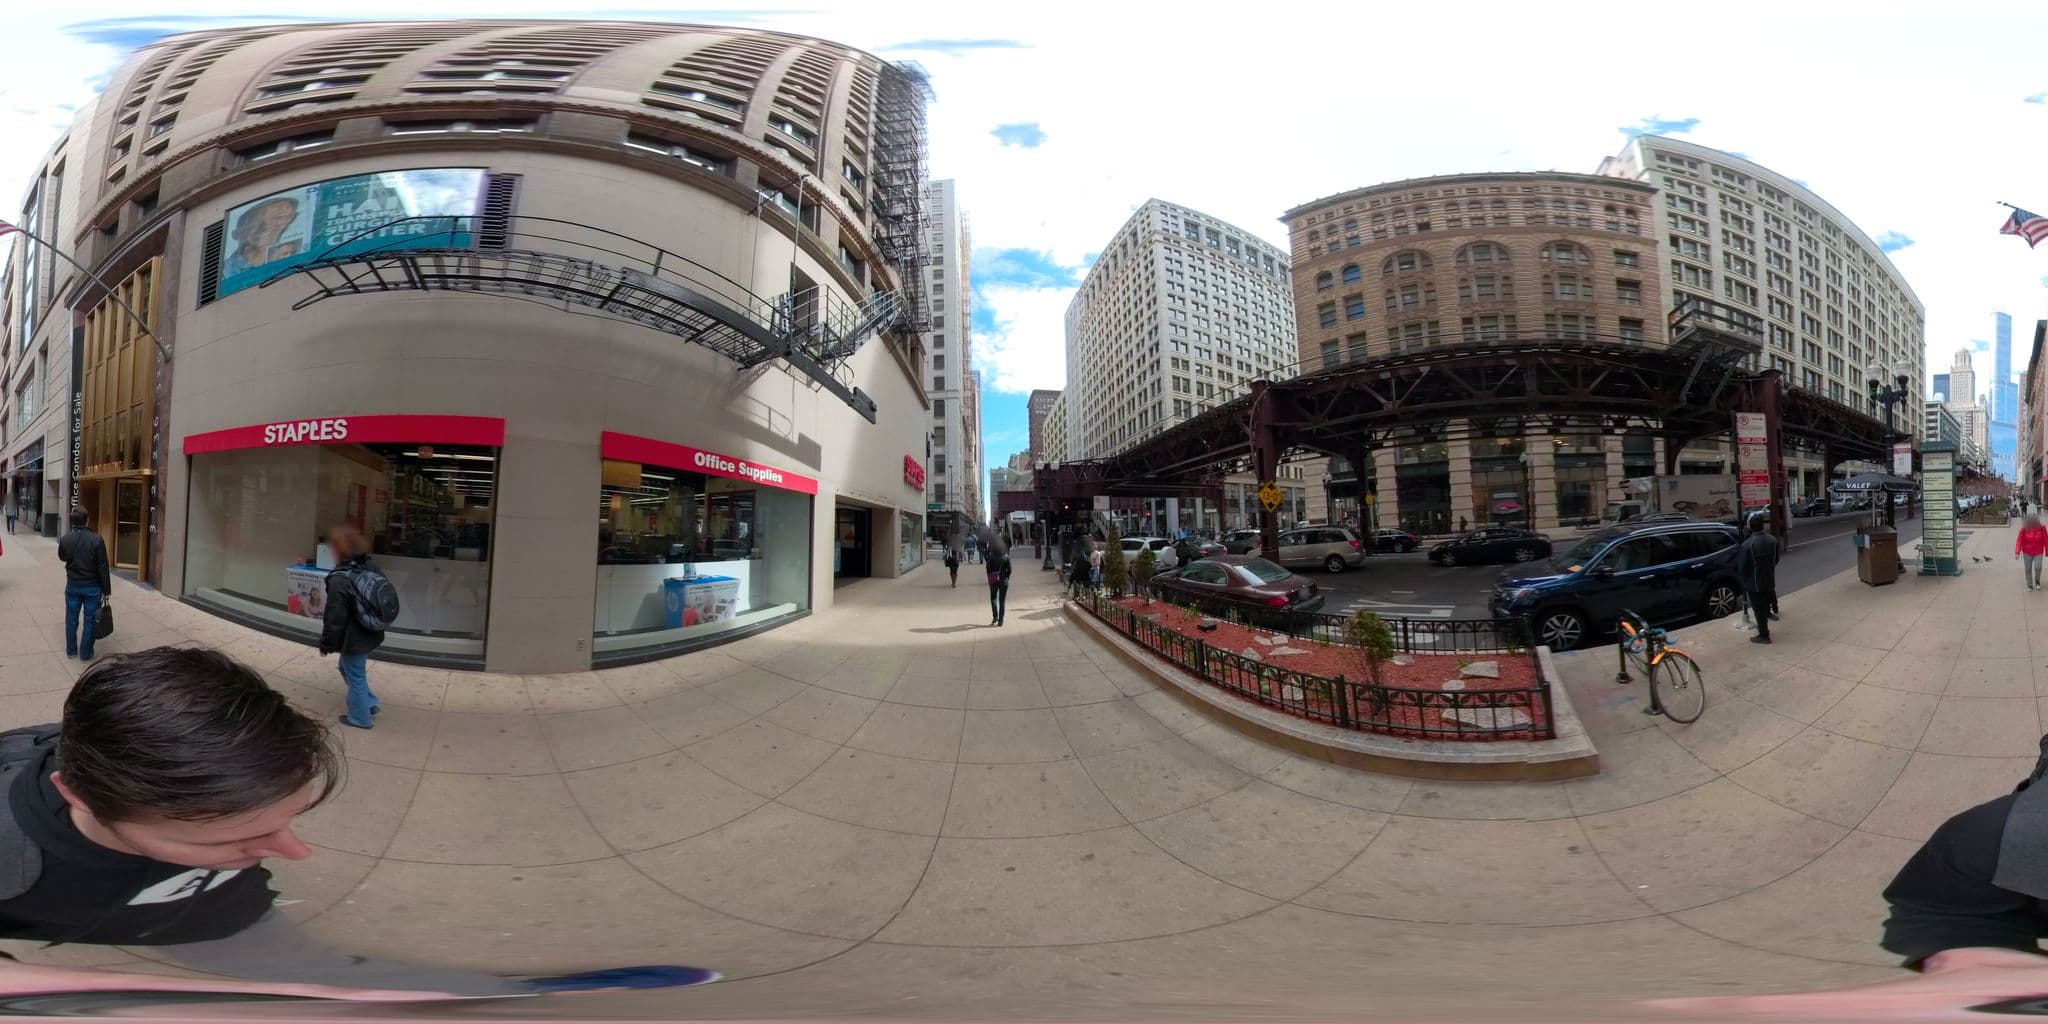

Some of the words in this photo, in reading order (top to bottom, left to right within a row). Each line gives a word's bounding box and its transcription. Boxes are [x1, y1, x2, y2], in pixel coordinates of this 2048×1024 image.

[327, 196, 400, 219] HAI
[325, 214, 433, 236] SURGI
[73, 392, 82, 416] Sale
[72, 417, 81, 434] for
[264, 419, 347, 443] STAPLES
[72, 435, 80, 480] Condos
[694, 451, 735, 473] Office
[738, 461, 783, 483] Supplies
